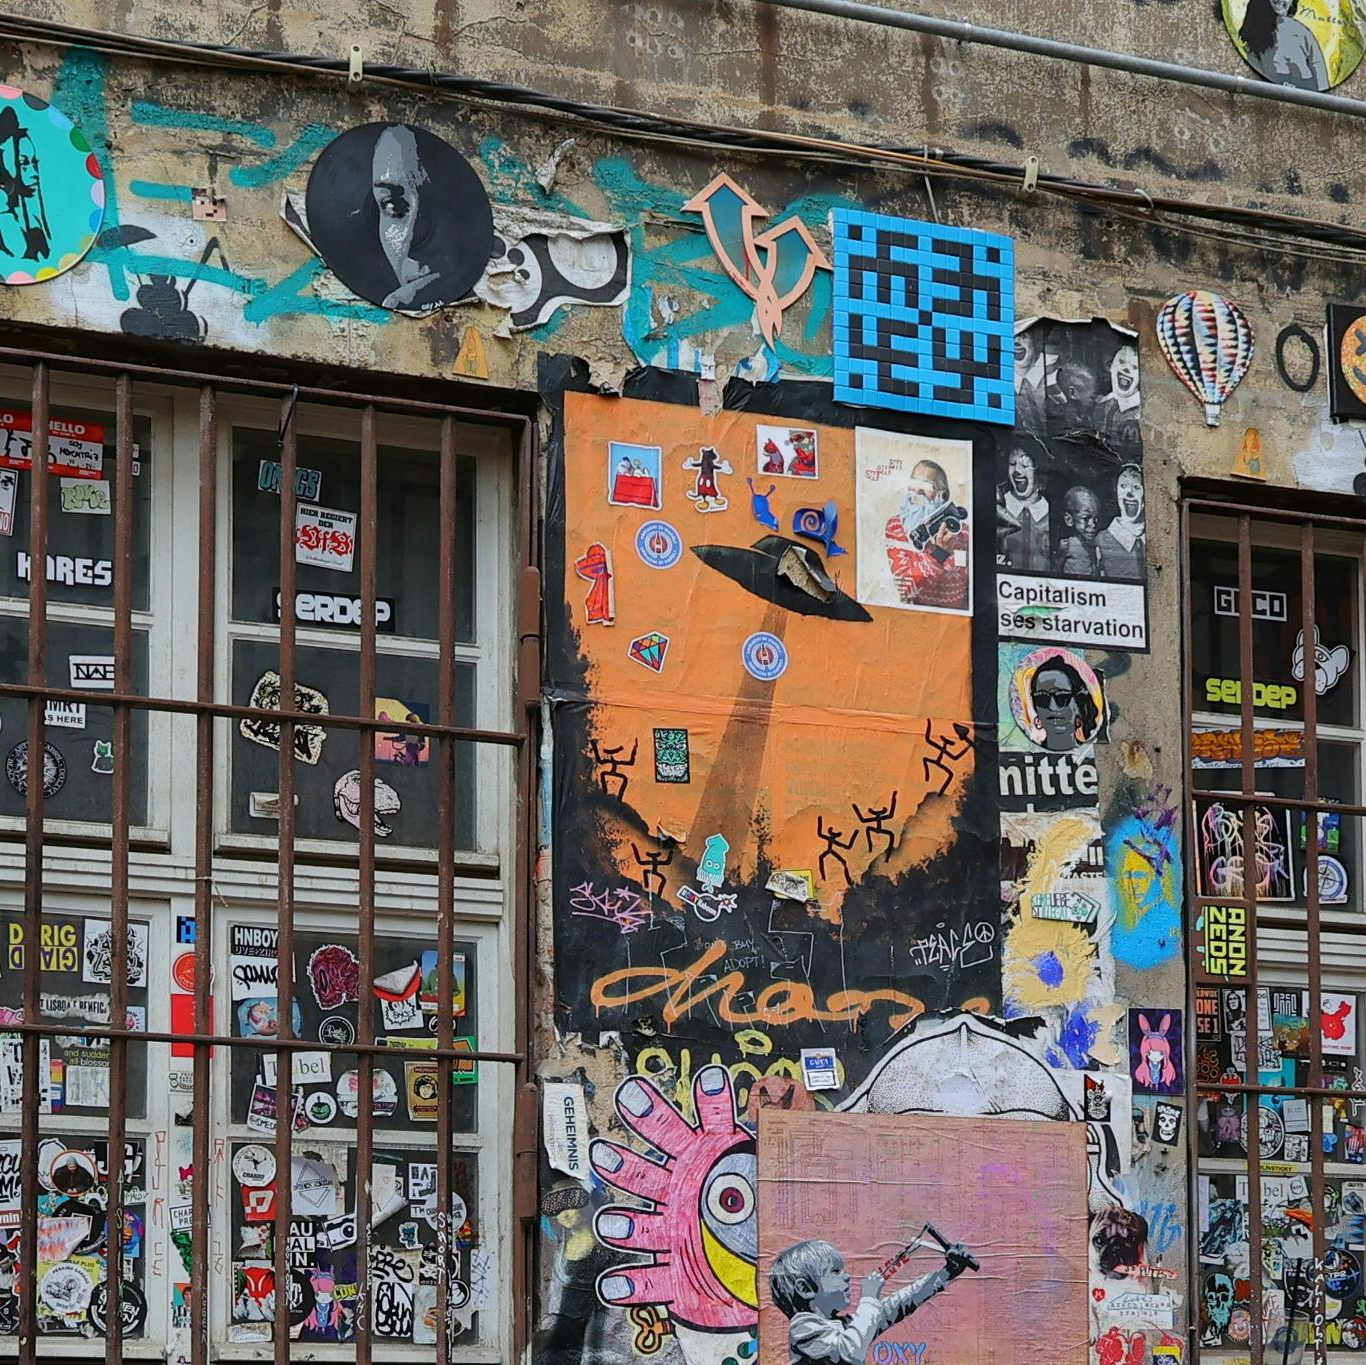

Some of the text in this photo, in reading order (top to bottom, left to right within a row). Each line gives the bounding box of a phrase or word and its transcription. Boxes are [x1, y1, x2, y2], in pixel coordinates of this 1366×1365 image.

[998, 580, 1107, 608] Capitalism
[1042, 615, 1145, 639] starvation
[57, 714, 84, 726] HERE
[563, 1096, 579, 1171] GEHEIMNIS
